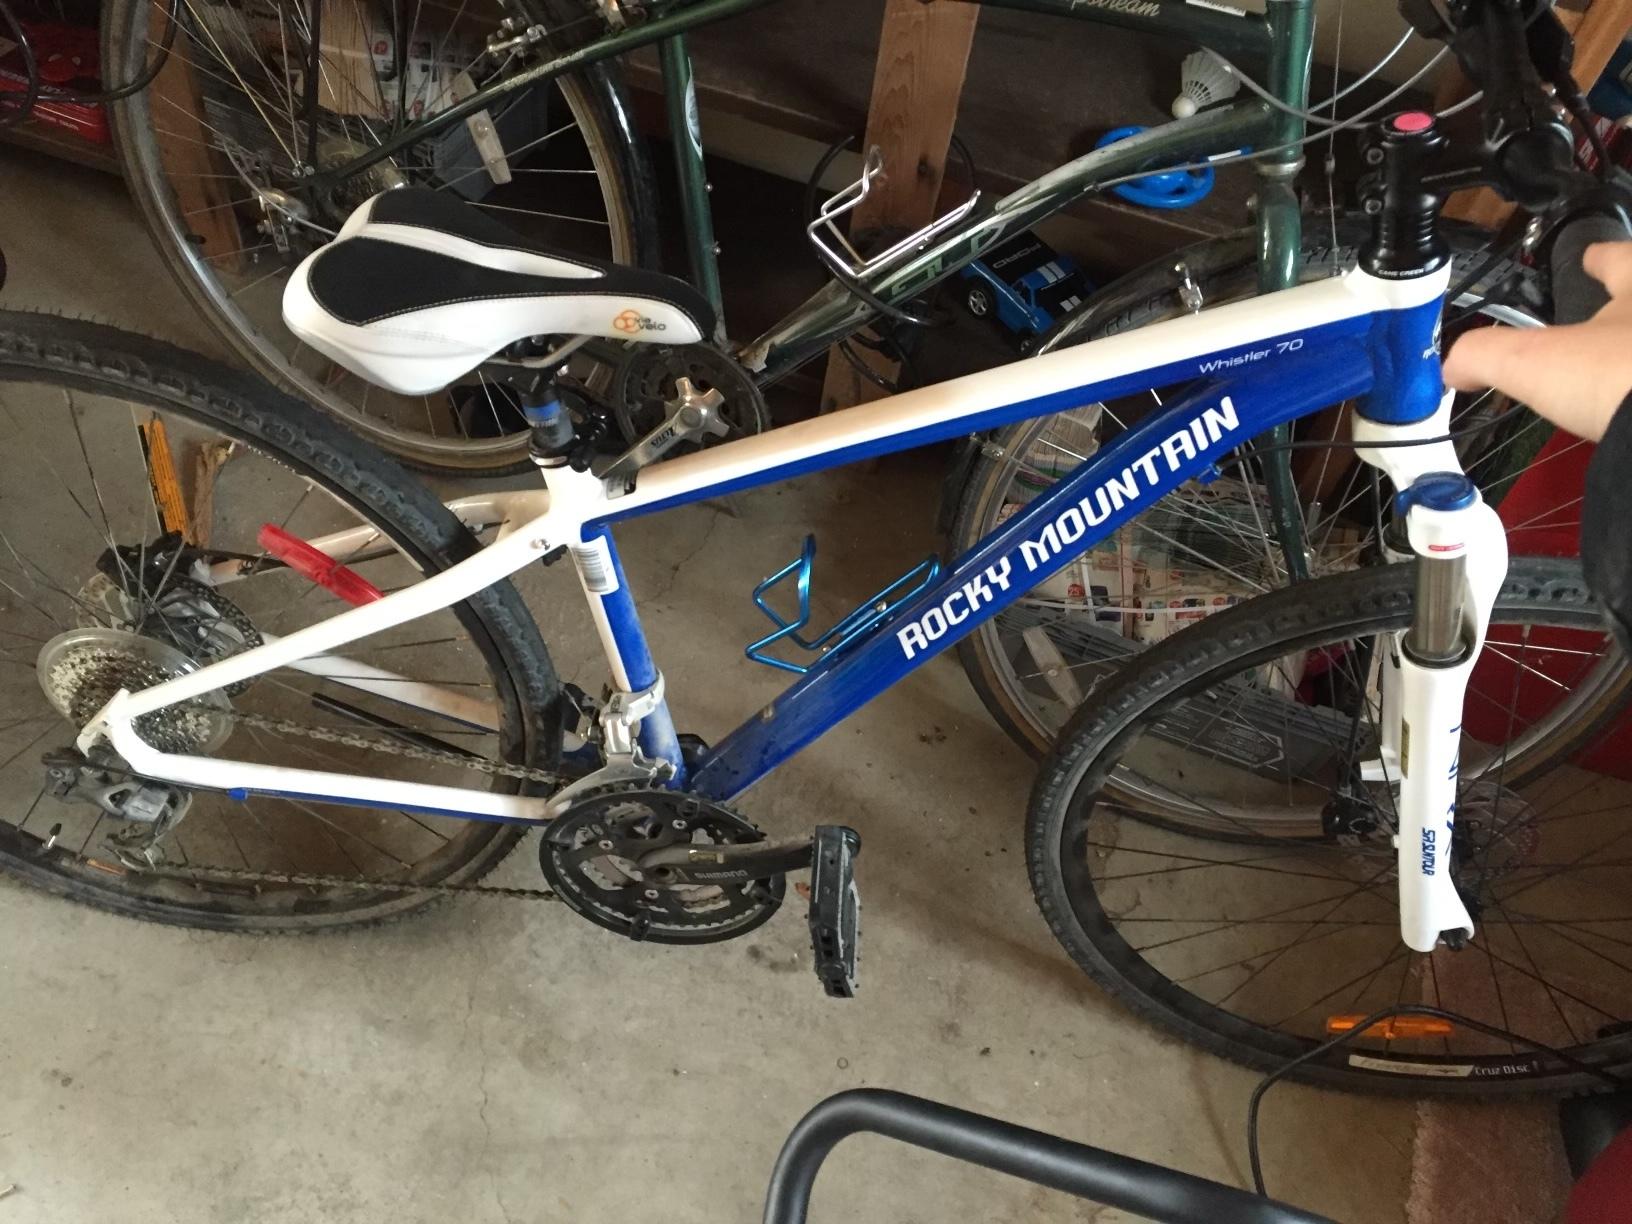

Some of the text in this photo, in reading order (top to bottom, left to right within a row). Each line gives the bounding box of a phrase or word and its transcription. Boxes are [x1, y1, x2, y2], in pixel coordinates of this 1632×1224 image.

[992, 242, 1041, 269] FORD
[1199, 338, 1304, 374] Whistler 70
[896, 395, 1240, 661] ROCKY MOUNTAIN
[1502, 1064, 1530, 1076] Disc
